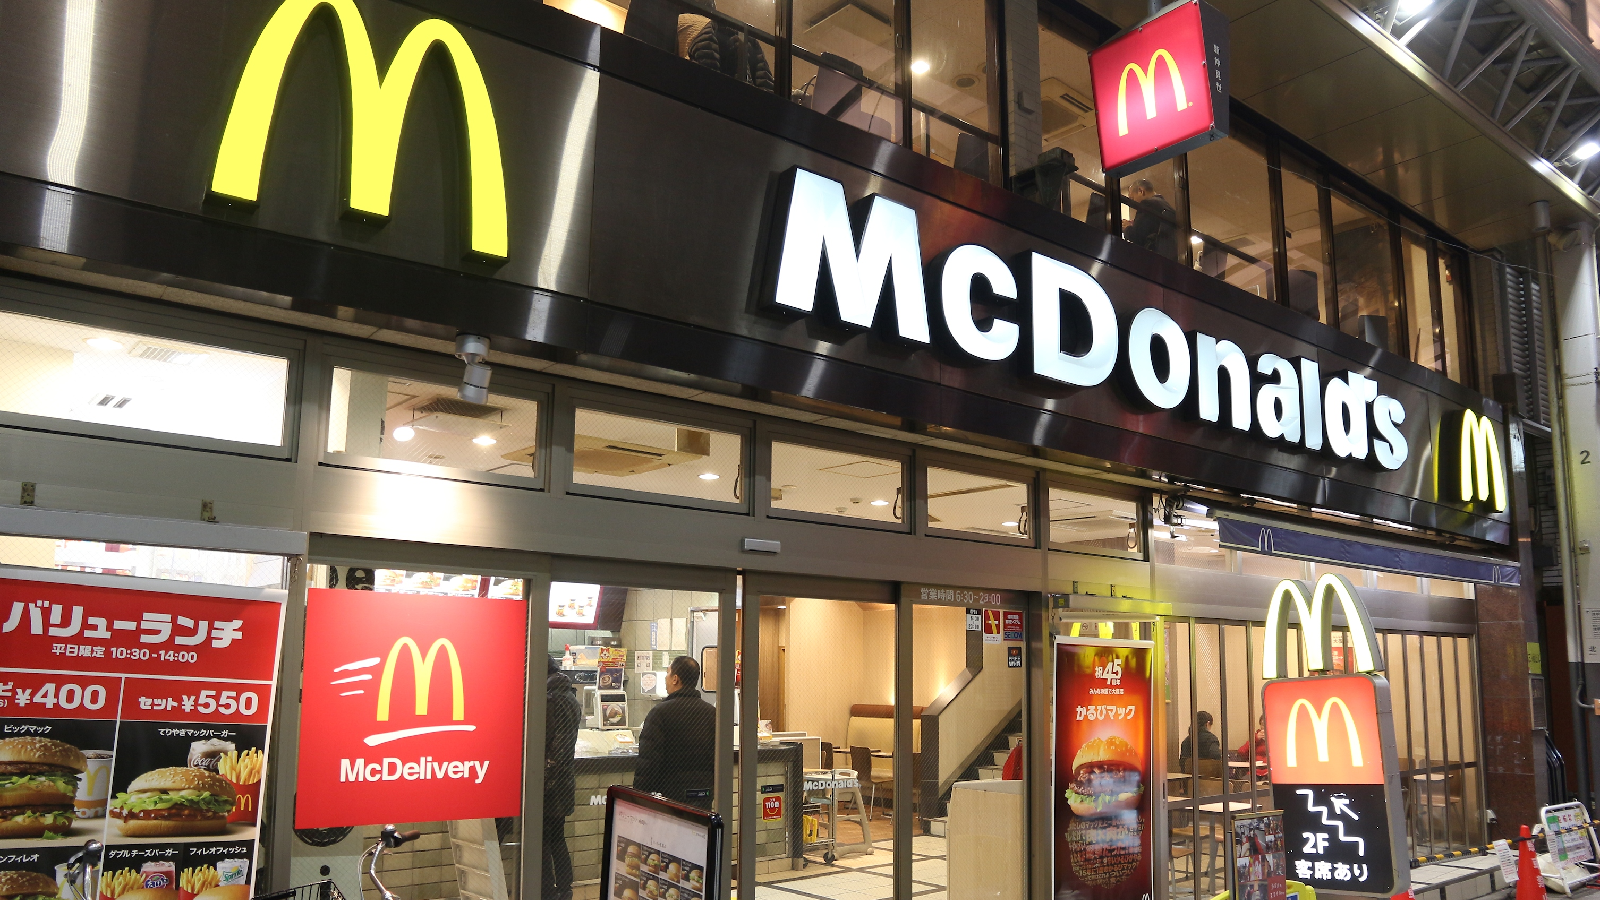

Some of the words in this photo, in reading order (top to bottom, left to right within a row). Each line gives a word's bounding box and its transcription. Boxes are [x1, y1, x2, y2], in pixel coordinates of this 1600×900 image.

[775, 167, 1409, 471] McDonald's
[1580, 450, 1591, 465] 2
[921, 588, 954, 602] 営業時間
[2, 600, 243, 648] バリューランチ
[52, 643, 105, 658] 平日限定
[15, 682, 107, 710] ¥400
[139, 696, 178, 711] セット
[182, 690, 259, 716] ¥550
[1076, 705, 1136, 720] かるびマック
[4, 724, 52, 734] ビッグマック
[158, 728, 236, 738] てりやきマックバーガー
[339, 757, 490, 784] McDelivery
[1302, 832, 1330, 854] 2F
[109, 848, 179, 858] ダブルチーズバーガー
[189, 846, 247, 856] フィレオフィッシュ
[1294, 859, 1369, 882] 客席あり
